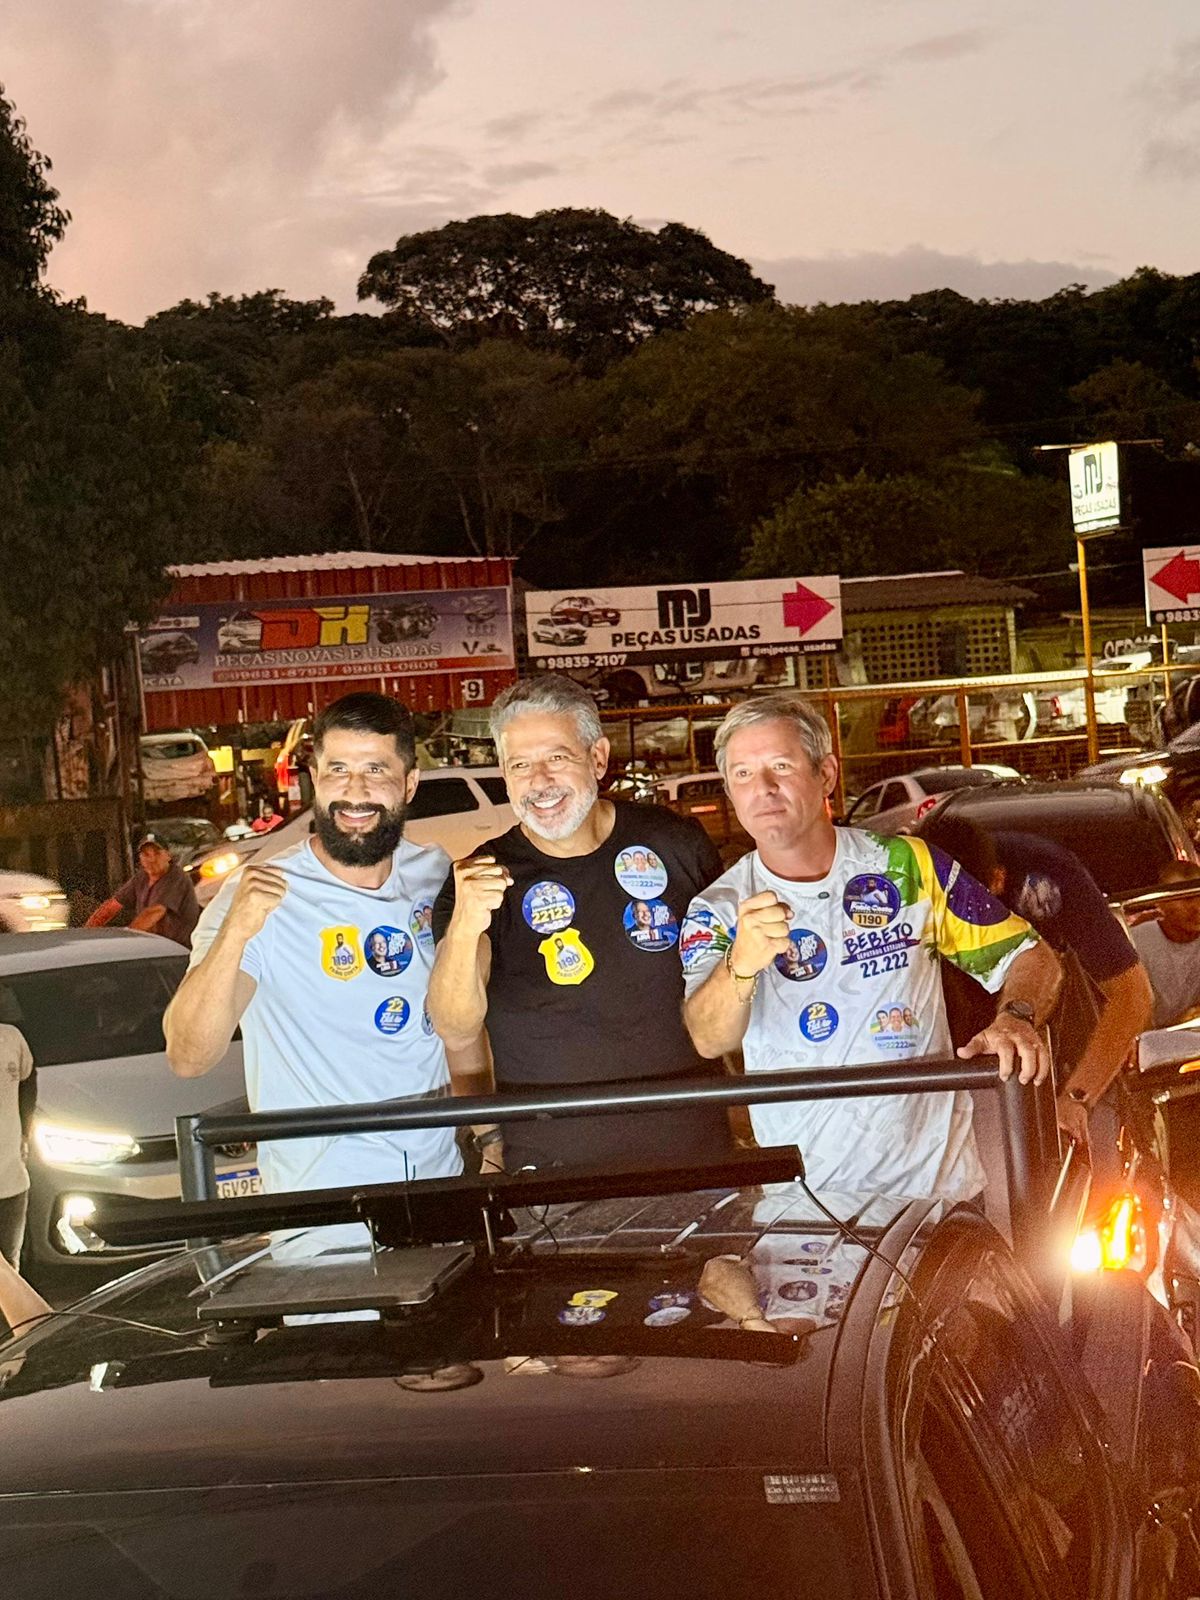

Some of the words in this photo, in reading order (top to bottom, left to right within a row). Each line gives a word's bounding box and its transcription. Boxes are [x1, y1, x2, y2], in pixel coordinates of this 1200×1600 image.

[1166, 609, 1200, 623] 9883
[612, 630, 676, 651] PEÇAS
[680, 624, 761, 643] USADAS
[281, 648, 345, 664] NOVAS
[350, 648, 362, 660] E
[367, 644, 442, 659] USADAS
[547, 654, 627, 669] 98839-2107
[466, 681, 480, 699] 9
[531, 905, 572, 926] 22123
[858, 914, 882, 925] 1190
[844, 922, 913, 954] BEBETO
[332, 954, 354, 966] 1190
[856, 947, 883, 960] DEPUTADO
[557, 954, 581, 969] 1190
[860, 951, 909, 979] 22.222
[386, 998, 404, 1012] 22
[808, 1004, 828, 1019] 22
[216, 1178, 262, 1197] GV9E
